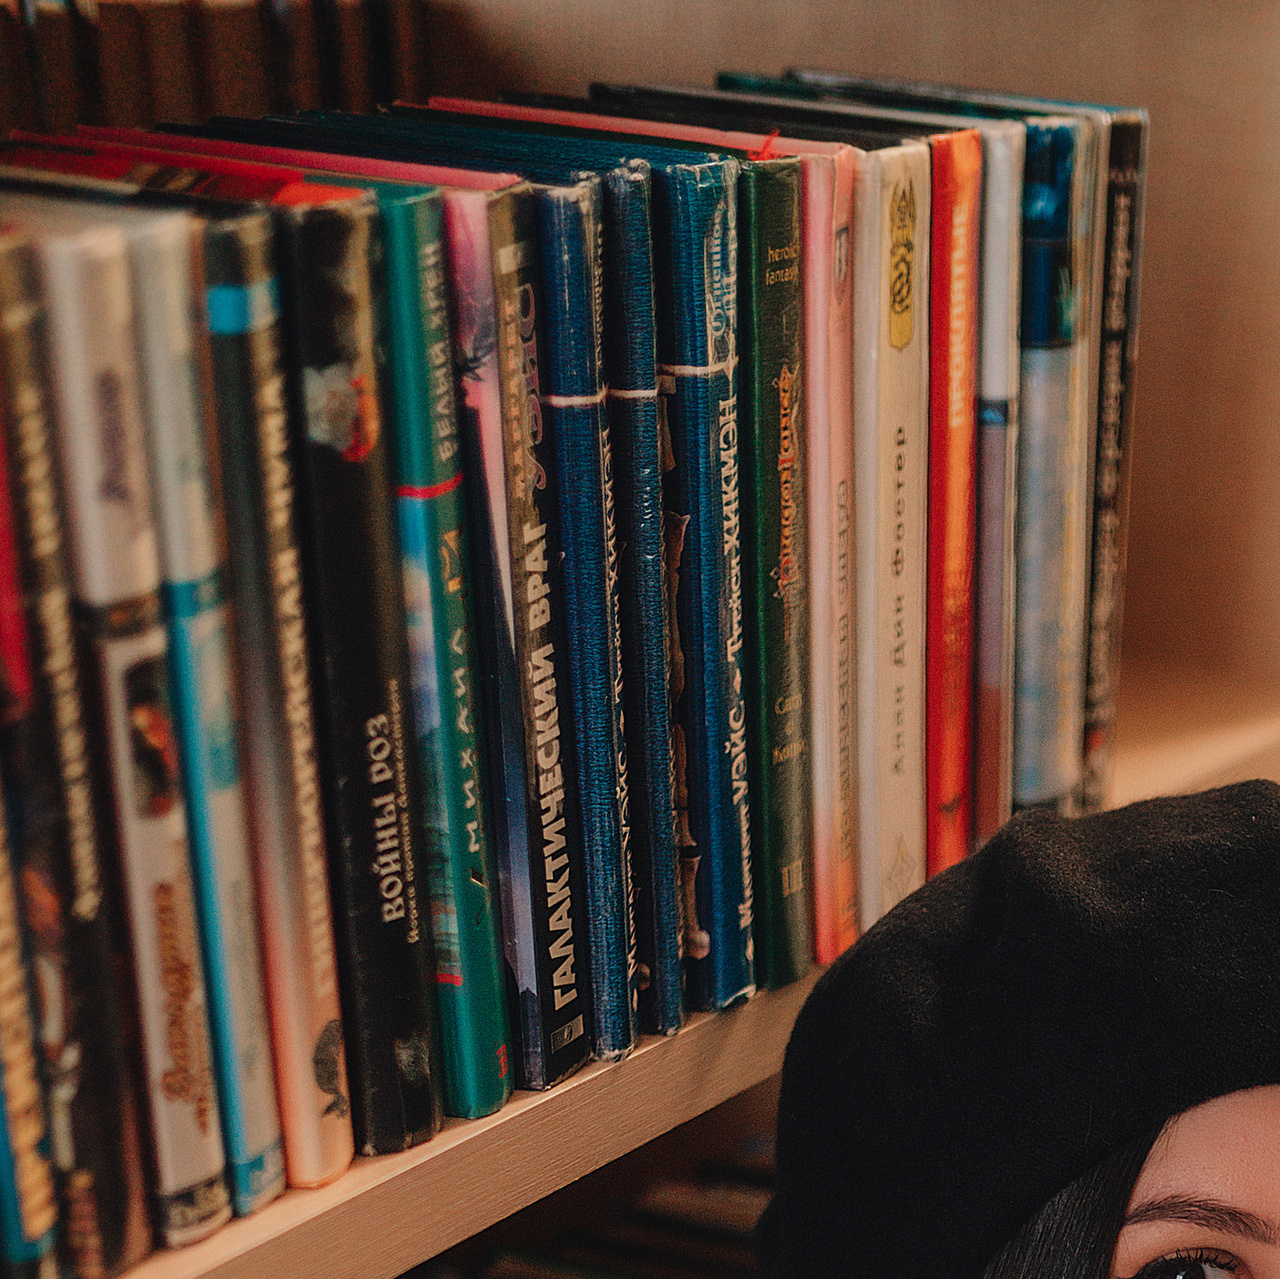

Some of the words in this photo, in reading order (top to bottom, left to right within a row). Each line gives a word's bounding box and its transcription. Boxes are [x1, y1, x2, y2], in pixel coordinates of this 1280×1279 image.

[946, 198, 969, 429] ПРОКЛЯТЫЕ
[426, 341, 458, 461] БЕЛЫЙ
[718, 395, 741, 556] ХИКМЭН
[522, 522, 554, 630] ВРАГ
[364, 712, 394, 785] РОЗ
[450, 629, 481, 853] МИХАИЛ
[371, 791, 406, 923] ВОЙНЫ
[527, 643, 579, 1011] ГАЛАКТИЧЕСКИЙ
